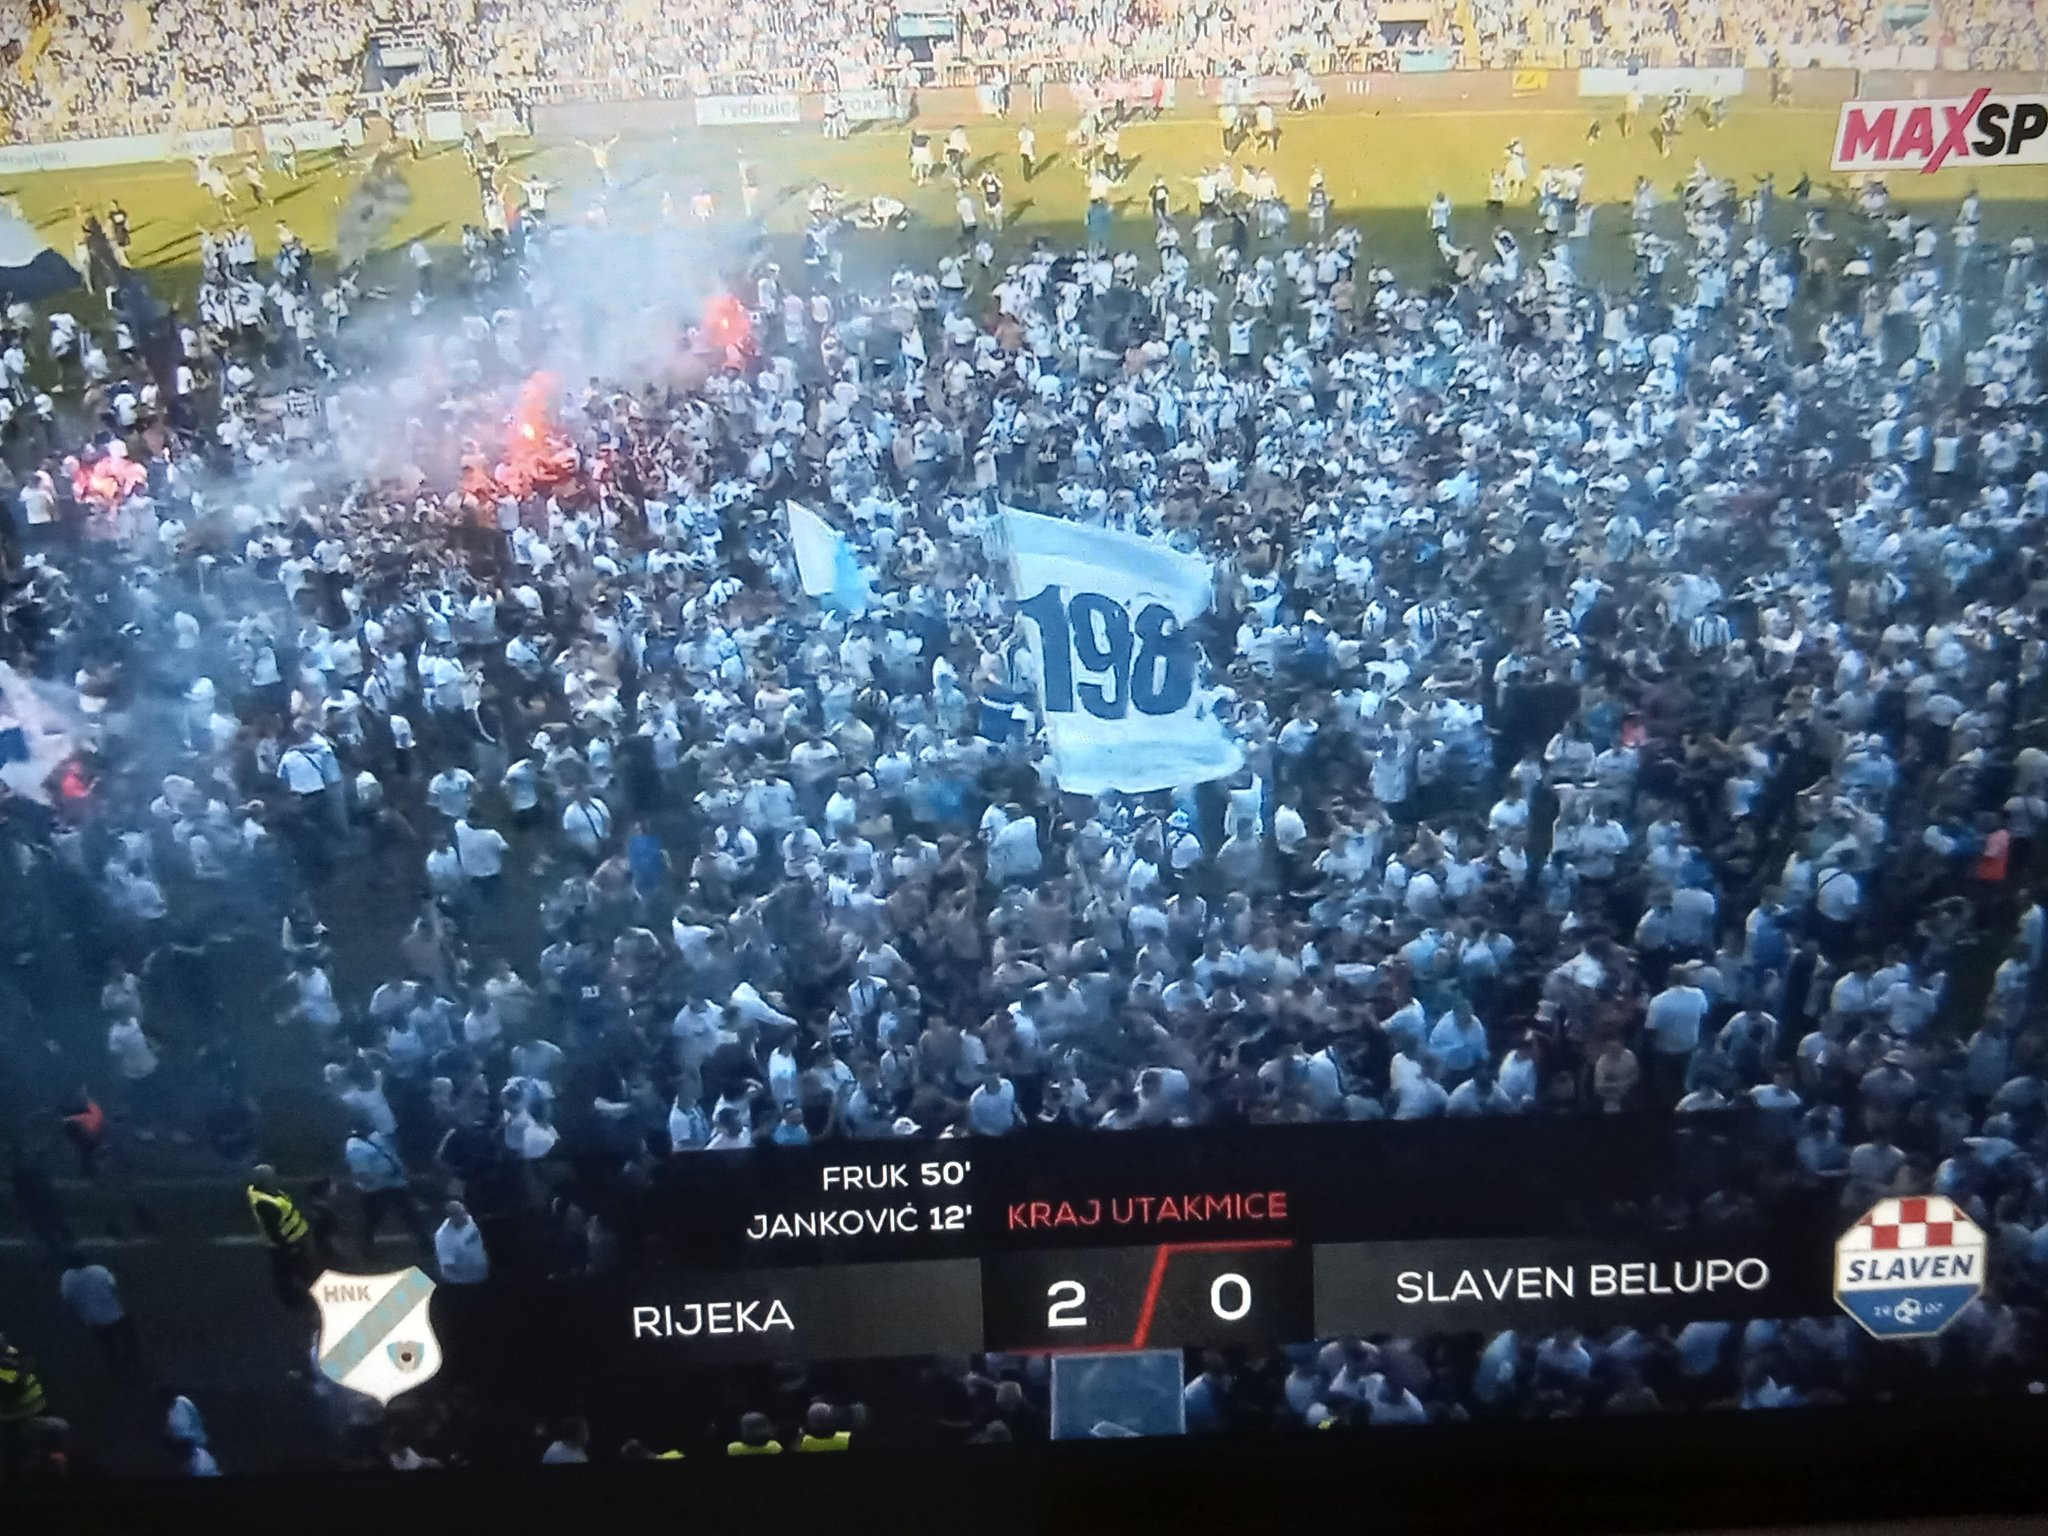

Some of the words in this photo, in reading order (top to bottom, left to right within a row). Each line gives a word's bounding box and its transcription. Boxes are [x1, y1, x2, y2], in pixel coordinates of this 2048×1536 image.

[822, 1163, 910, 1192] FRUK
[919, 1160, 971, 1188] 50'
[746, 1202, 919, 1240] JANKOVIĆ
[929, 1204, 974, 1231] 12'
[1008, 1199, 1101, 1230] KRAJ
[1112, 1192, 1288, 1224] UTAKMICE
[1396, 1265, 1575, 1305] SLAVEN
[1590, 1257, 1770, 1297] BELUPO
[1847, 1253, 1974, 1283] SLAVEN
[323, 1284, 371, 1303] HNK
[1047, 1279, 1088, 1328] 2
[1210, 1272, 1252, 1322] 0
[632, 1299, 796, 1339] RIJEKA
